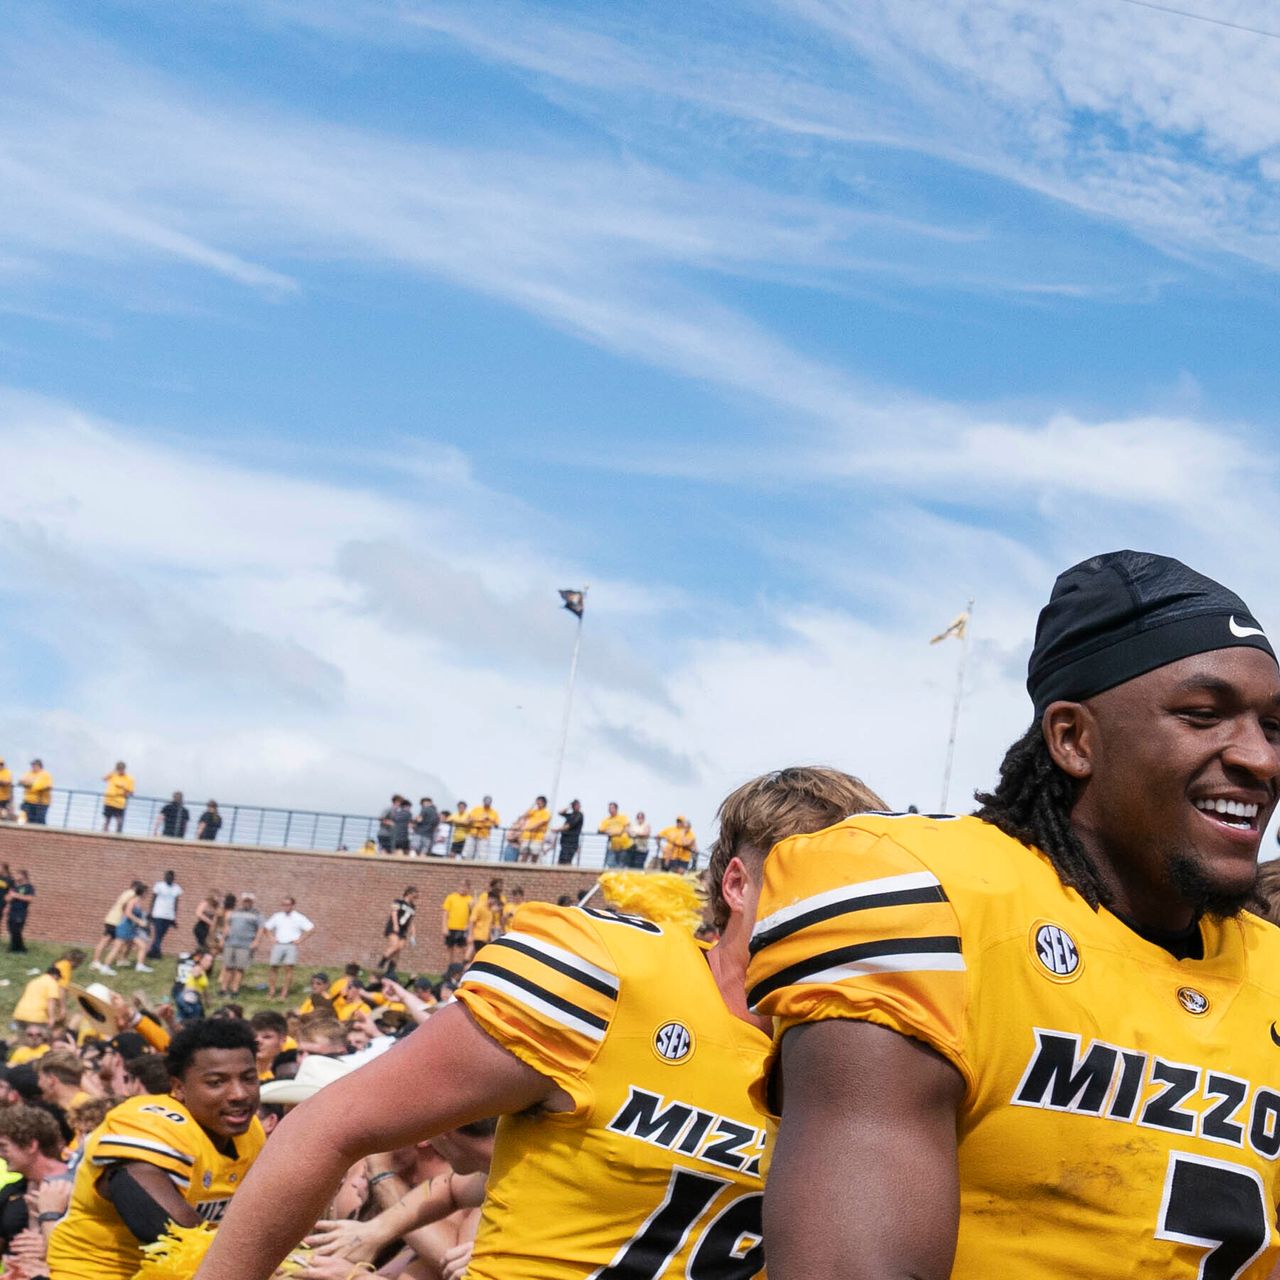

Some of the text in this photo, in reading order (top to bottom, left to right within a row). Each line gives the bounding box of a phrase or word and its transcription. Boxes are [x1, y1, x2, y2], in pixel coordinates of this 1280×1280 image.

[1036, 924, 1079, 975] SEC
[656, 1023, 691, 1060] SEC
[606, 1084, 765, 1177] MIZ
